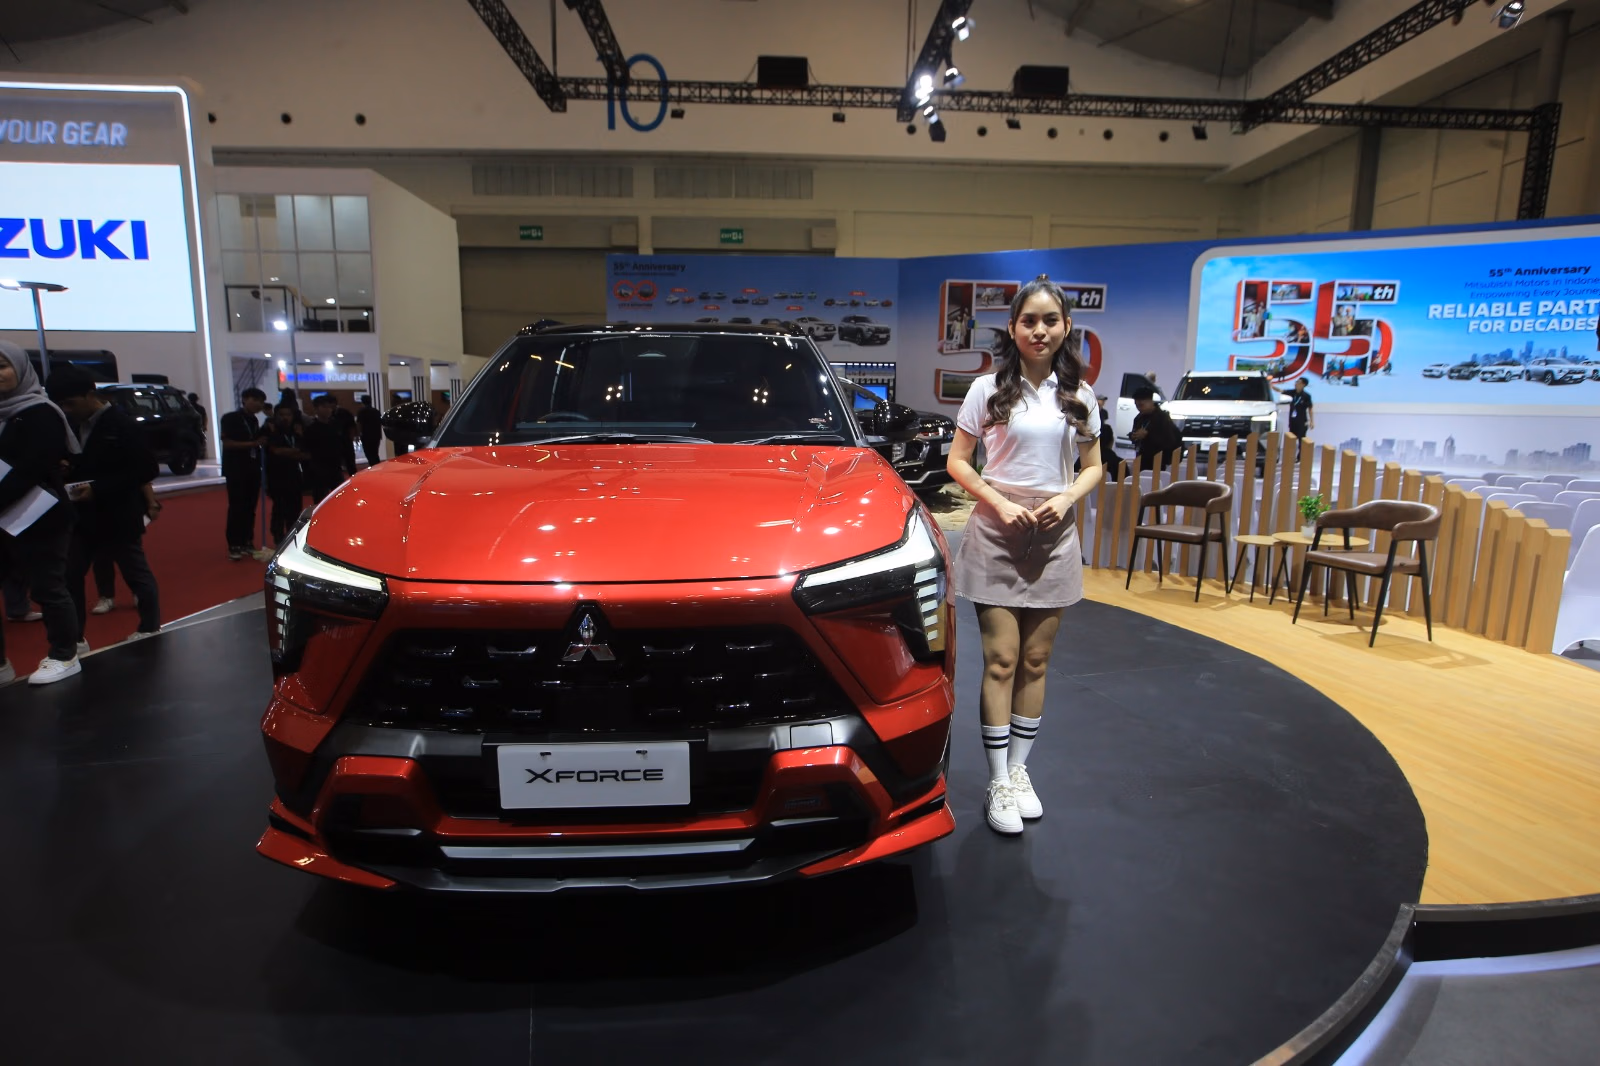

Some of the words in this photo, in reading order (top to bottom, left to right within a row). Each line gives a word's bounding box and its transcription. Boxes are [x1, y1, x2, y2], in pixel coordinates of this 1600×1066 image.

[596, 53, 669, 132] 10
[62, 121, 128, 146] GEAR
[1514, 265, 1591, 276] Anniversary
[1464, 279, 1513, 289] Mitsubishi
[1515, 278, 1550, 288] Motors
[1552, 278, 1562, 286] in
[1470, 290, 1530, 299] Empowering
[1533, 289, 1561, 298] Every
[1428, 301, 1533, 319] RELIABLE
[1537, 299, 1600, 316] PART
[1468, 319, 1506, 333] FOR
[1509, 317, 1599, 332] DECADES
[525, 768, 664, 784] XFORCE
